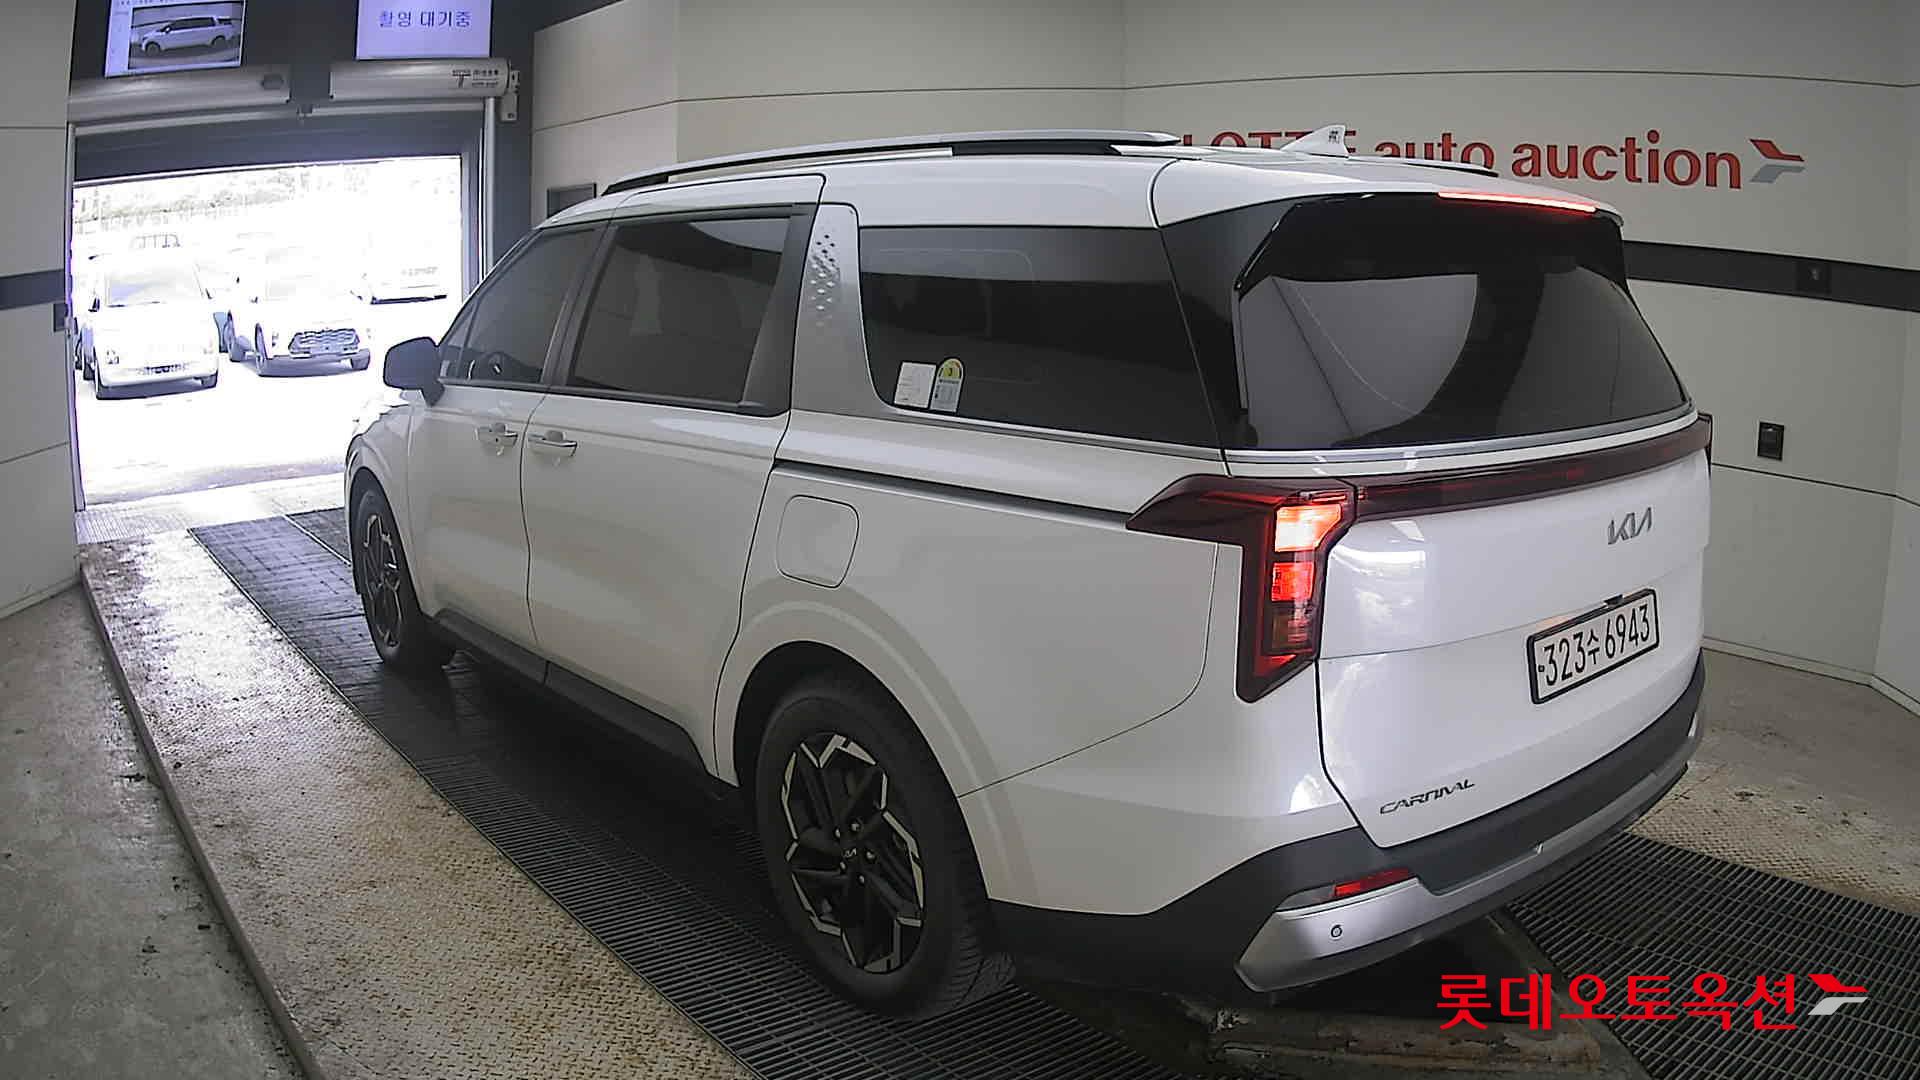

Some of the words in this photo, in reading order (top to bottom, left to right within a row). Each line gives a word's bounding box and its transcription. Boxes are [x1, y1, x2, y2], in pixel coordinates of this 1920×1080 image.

[420, 11, 470, 27] 대기중
[1511, 129, 1742, 189] auction
[1380, 779, 1475, 814] CARNIVAL
